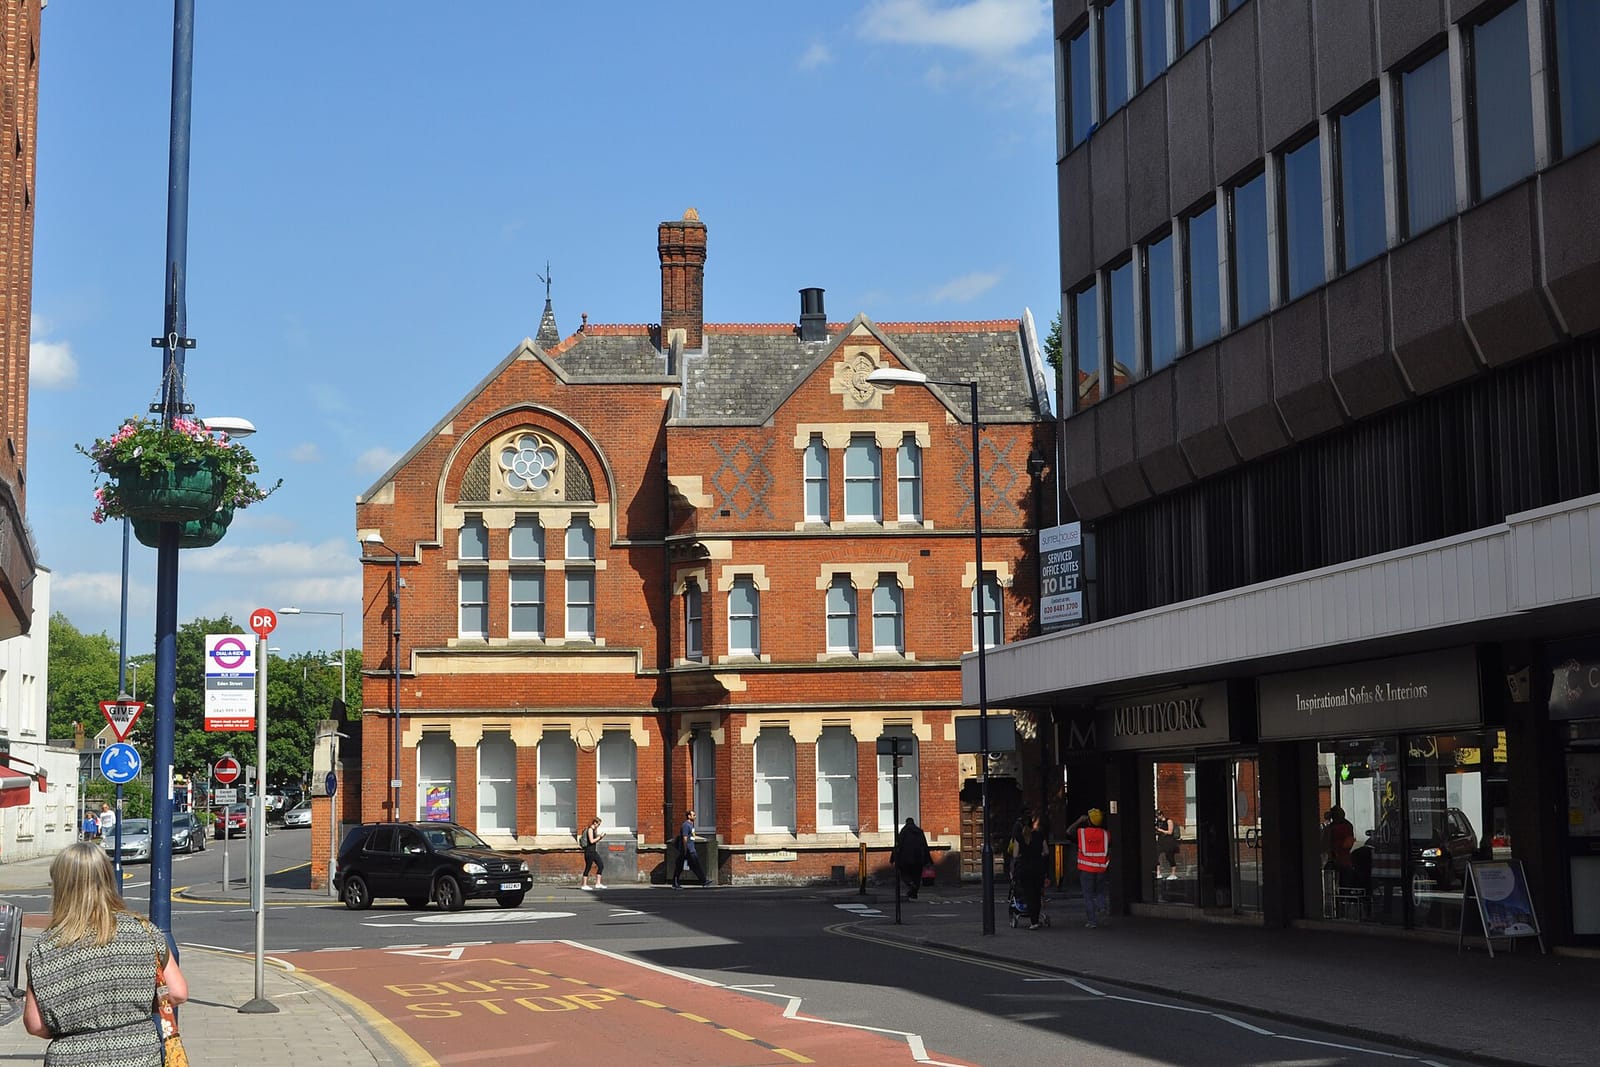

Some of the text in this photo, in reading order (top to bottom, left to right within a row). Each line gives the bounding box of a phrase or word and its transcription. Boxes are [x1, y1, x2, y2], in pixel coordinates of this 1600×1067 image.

[1048, 550, 1072, 564] SERVICED
[1043, 561, 1079, 577] OFFICE SUITES
[1042, 574, 1079, 594] TO LET
[253, 615, 272, 627] DR
[1296, 682, 1428, 715] Inspirational Sofas & Interiors
[109, 707, 134, 715] GIVE
[1113, 698, 1203, 737] MULTIYORK
[1068, 720, 1096, 749] M
[383, 978, 551, 997] BUS
[405, 993, 617, 1018] STOP
